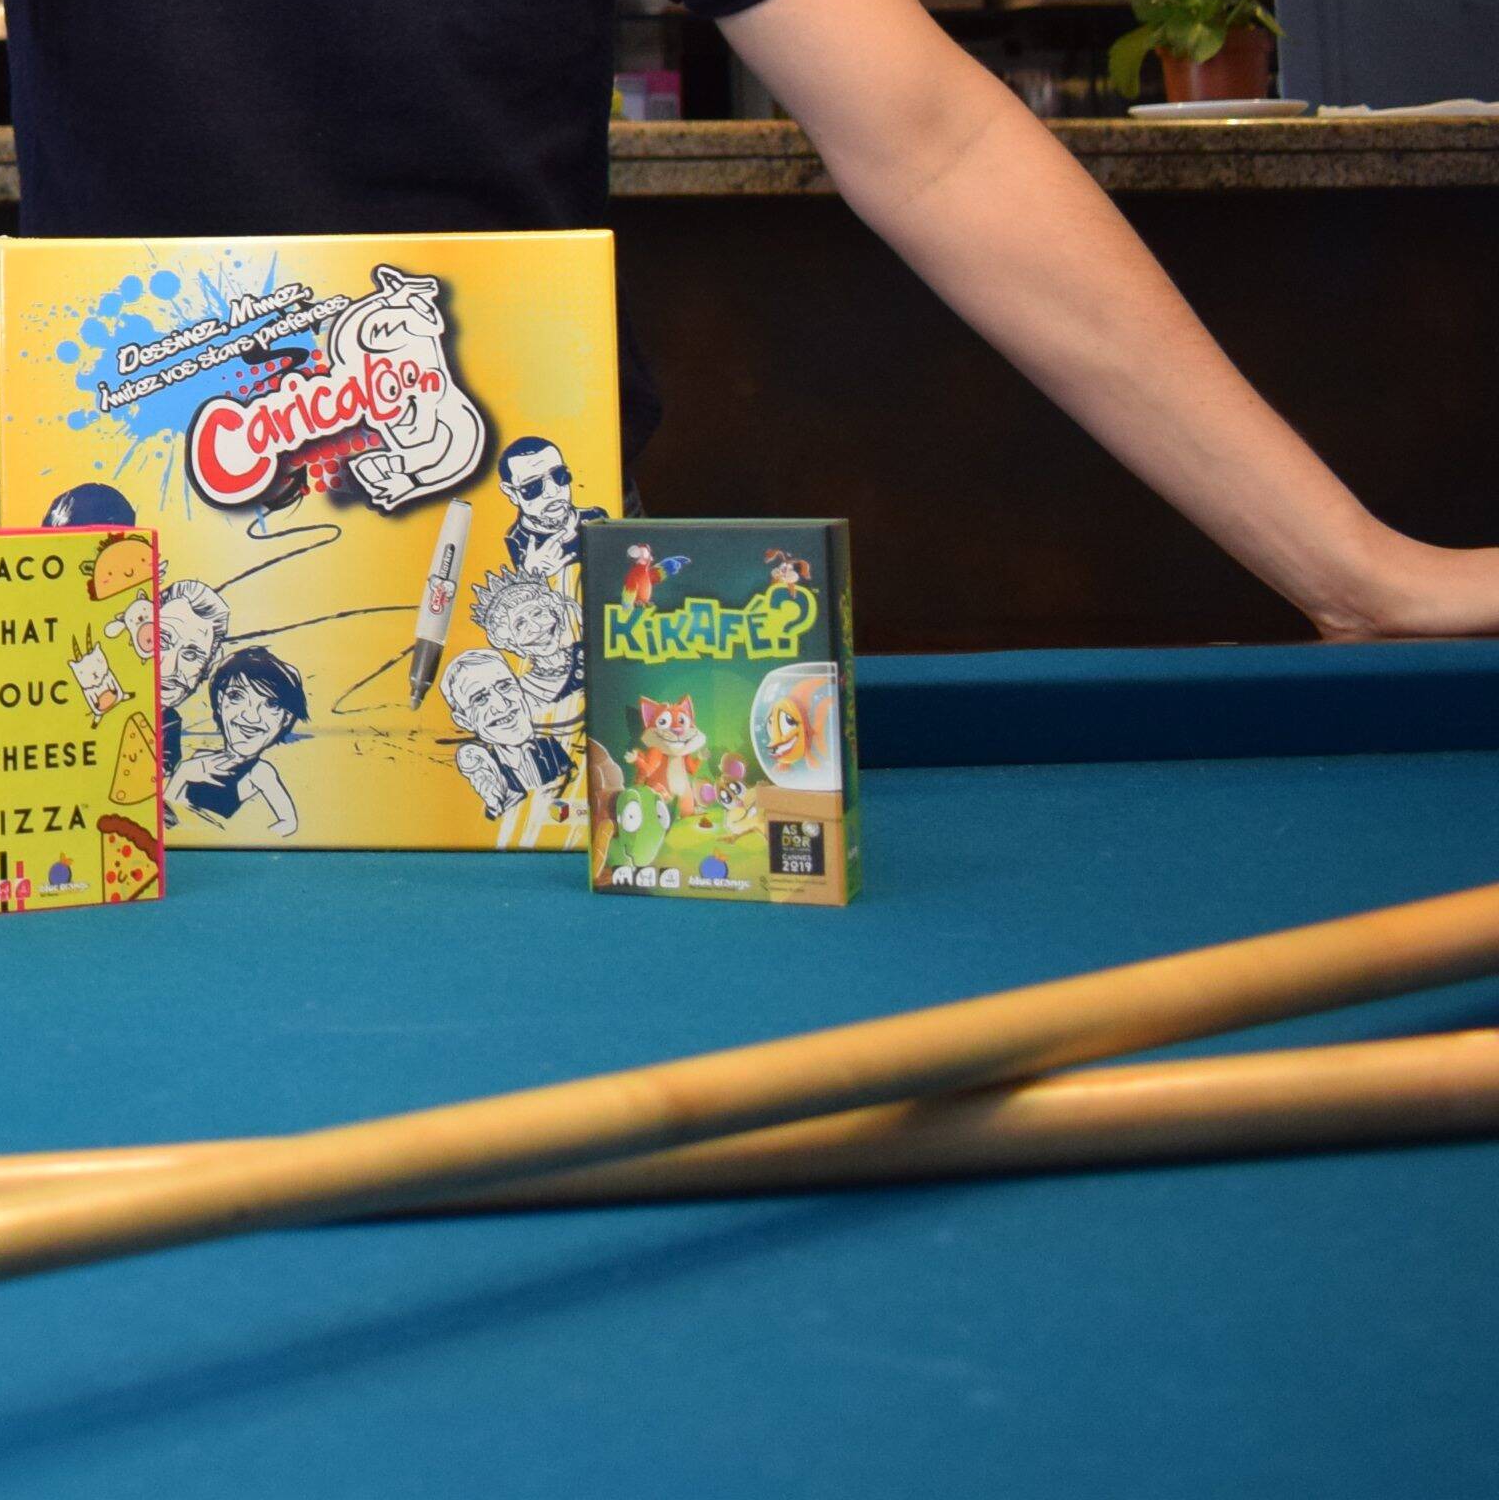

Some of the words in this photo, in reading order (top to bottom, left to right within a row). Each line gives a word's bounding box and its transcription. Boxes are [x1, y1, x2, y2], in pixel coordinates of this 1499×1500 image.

[161, 361, 198, 384] vos
[198, 336, 255, 368] stars
[782, 823, 798, 836] AS
[781, 860, 813, 873] 2019
[687, 874, 713, 887] blue
[714, 877, 751, 890] orange
